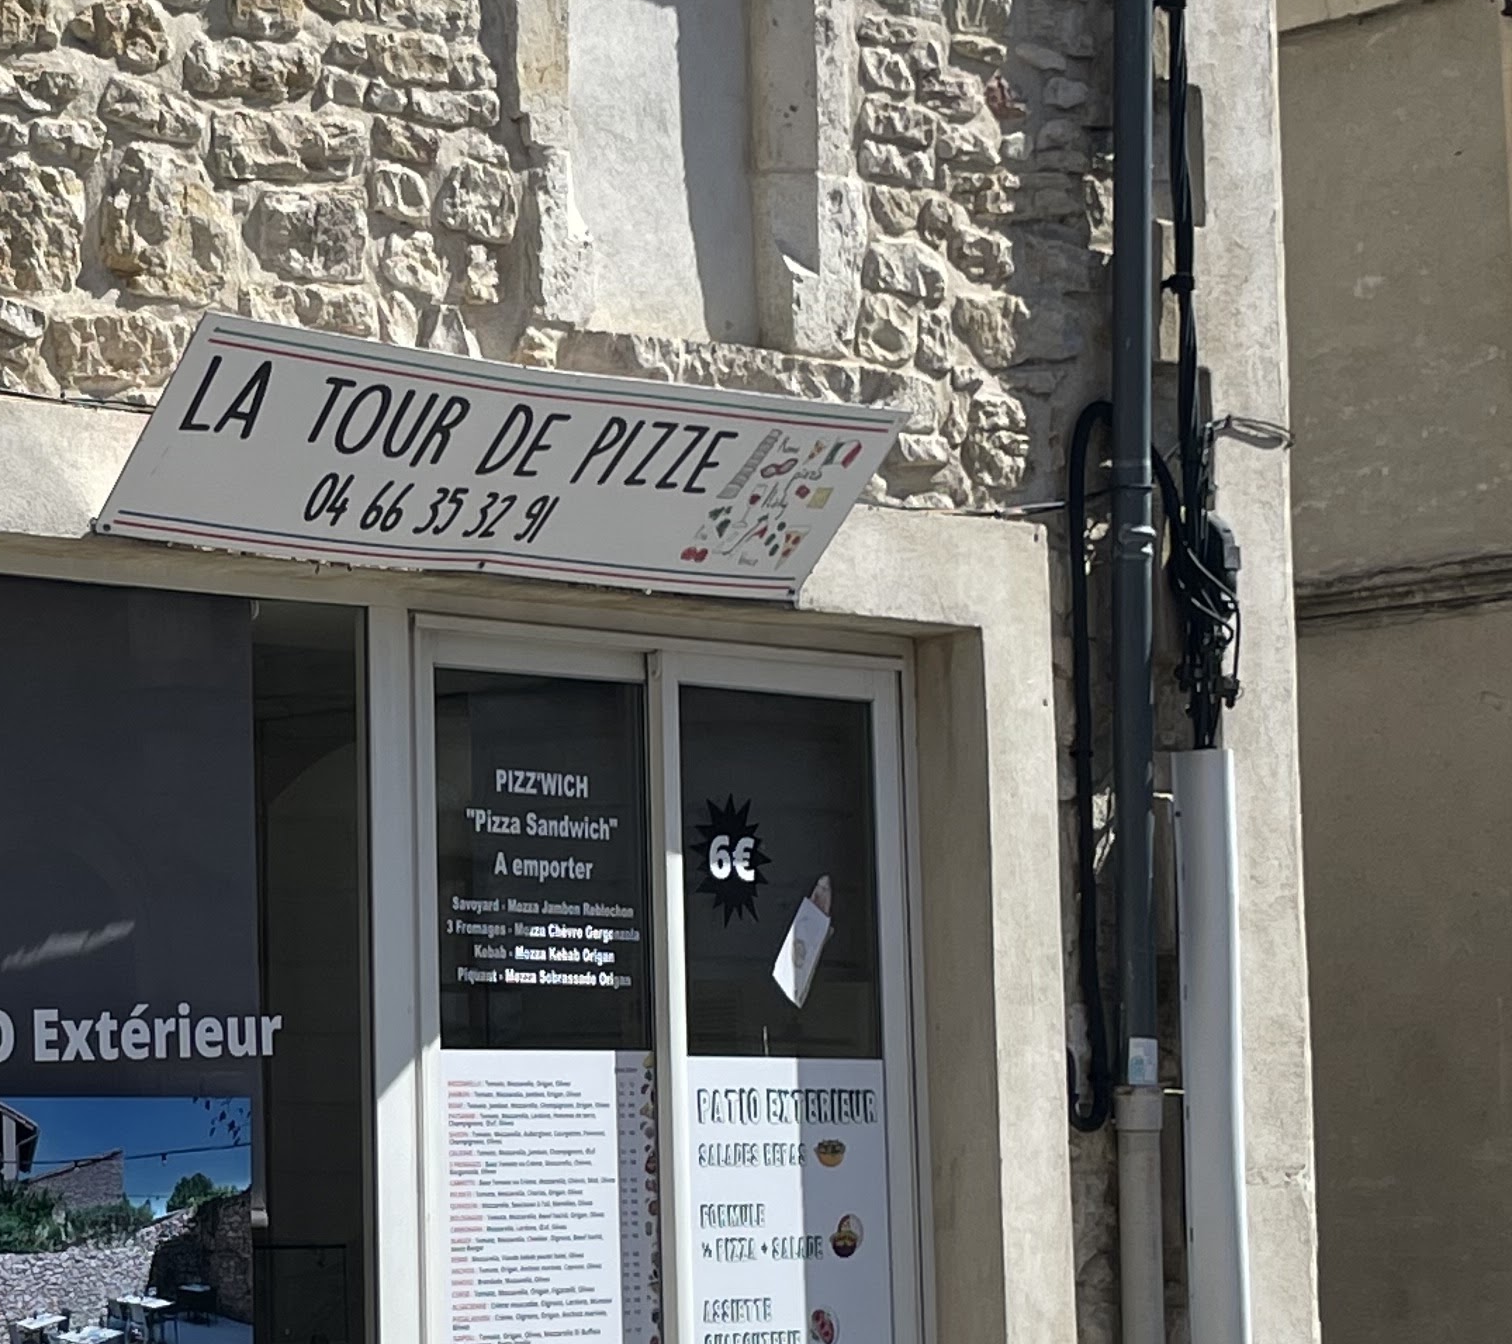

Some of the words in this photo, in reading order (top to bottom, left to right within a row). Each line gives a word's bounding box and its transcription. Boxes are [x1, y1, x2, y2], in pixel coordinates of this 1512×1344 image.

[179, 355, 274, 441] LA
[307, 377, 471, 465] TOUR
[475, 403, 570, 478] DE
[571, 419, 739, 495] PIZZE
[305, 472, 349, 525] 04
[360, 482, 398, 532] 66
[413, 487, 460, 536] 35
[463, 493, 514, 540] 32
[523, 496, 559, 544] 91
[495, 768, 589, 799] PIZZ'WICH
[465, 807, 522, 835] "Pizza
[525, 811, 619, 841] Sandwich"
[493, 851, 509, 876] A
[511, 856, 594, 884] emporter
[708, 834, 756, 882] 6€
[452, 895, 500, 915] Savoyard
[507, 898, 540, 915] Mozza
[541, 900, 581, 916] Jambon
[582, 902, 634, 919] Reblochon
[446, 919, 455, 935] 3
[455, 919, 507, 939] Fromages
[514, 921, 547, 938] Mozza
[473, 943, 507, 960] Kebab
[514, 945, 547, 961] Mozza
[547, 946, 581, 963] Kebab
[582, 947, 615, 967] Origan
[457, 966, 498, 985] Piquant
[504, 968, 537, 984] Mozza
[598, 972, 632, 990] Origan
[32, 1002, 283, 1063] Extérieur
[697, 1087, 761, 1125] PATIO
[766, 1087, 879, 1125] EXTERIEUR
[698, 1142, 760, 1168] SALADES
[699, 1202, 767, 1229] FORMULE
